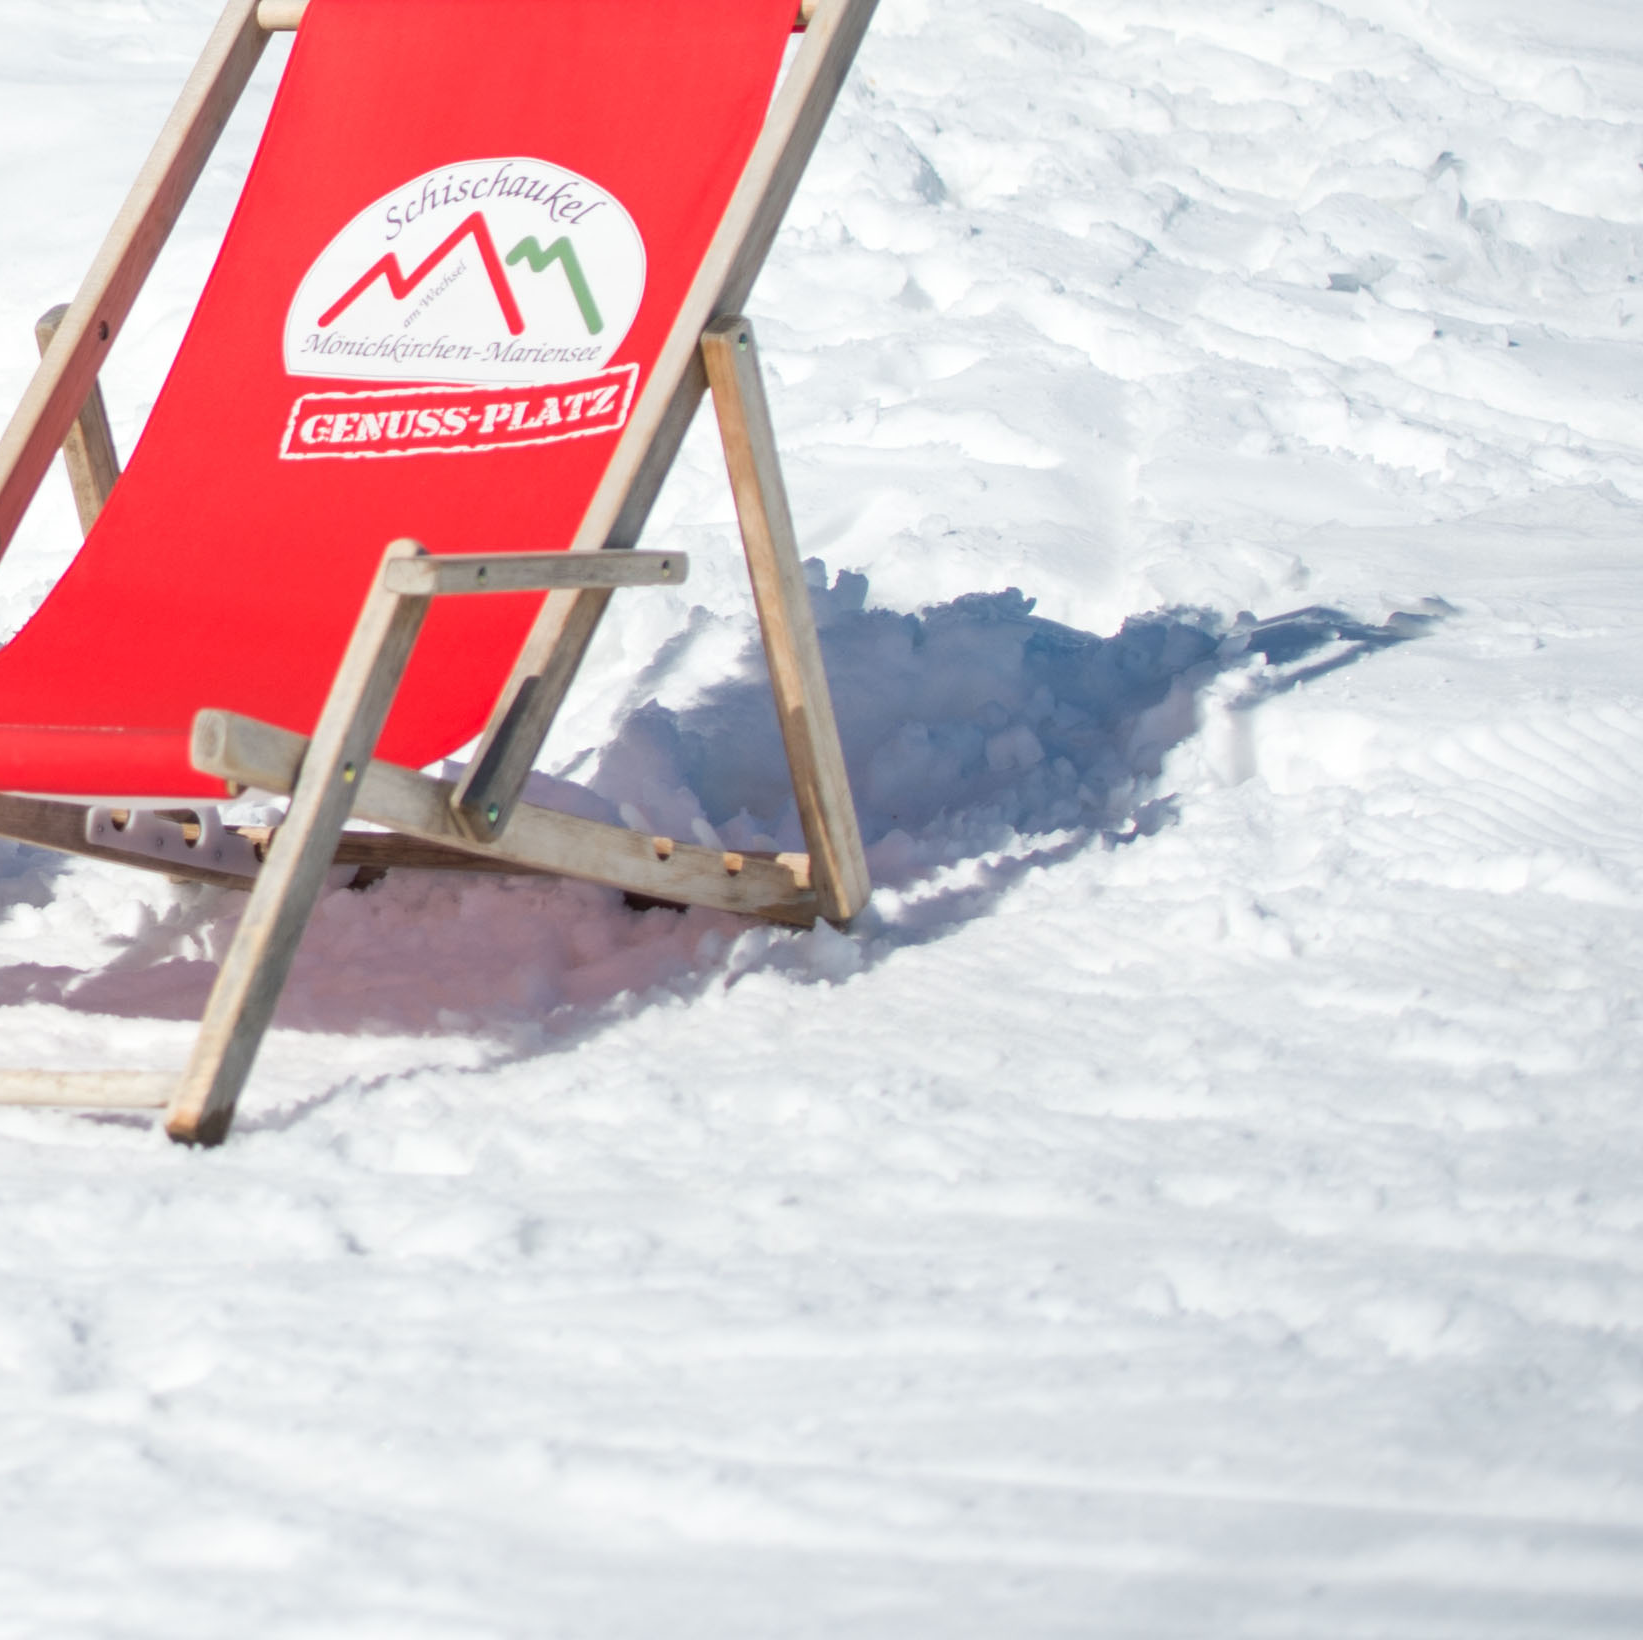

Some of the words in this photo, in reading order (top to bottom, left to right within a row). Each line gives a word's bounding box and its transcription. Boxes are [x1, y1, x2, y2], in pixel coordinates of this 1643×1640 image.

[385, 161, 608, 241] Schischaukel
[403, 308, 422, 329] am
[418, 256, 468, 308] Wechsel
[301, 332, 603, 365] Mönichkirchen-Mariensee
[299, 384, 620, 446] GENUSS-PLATZ
